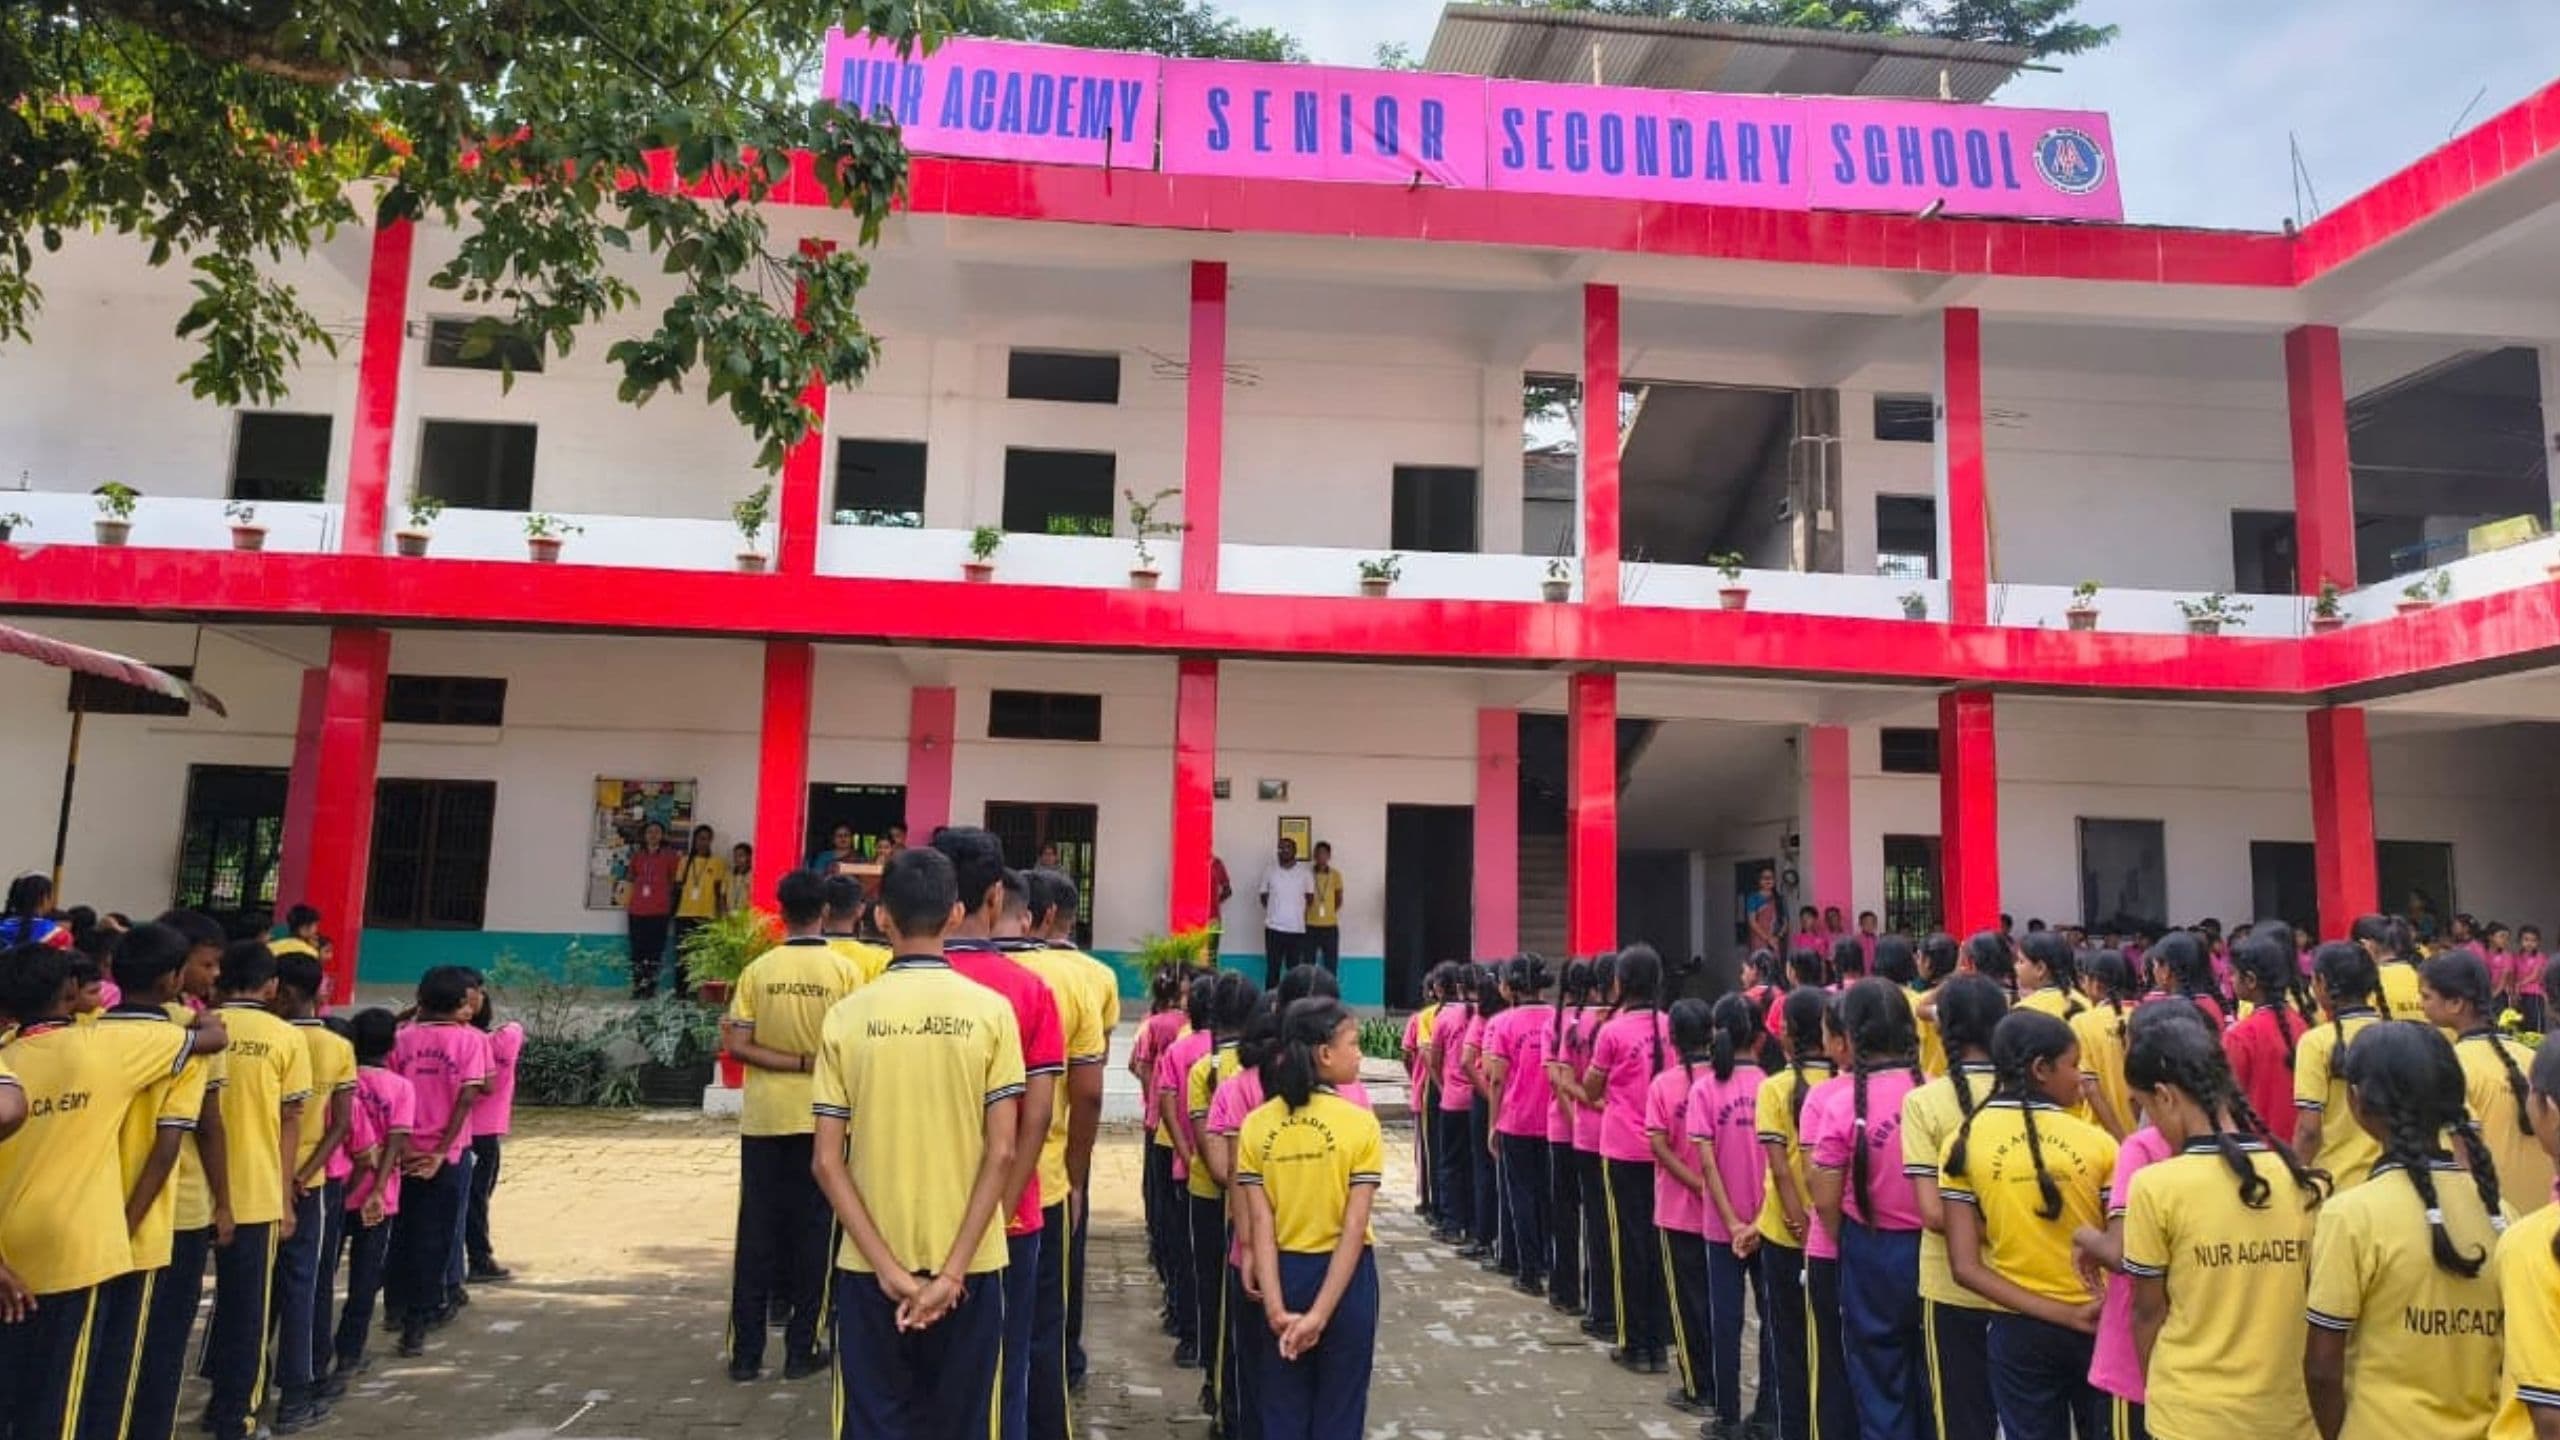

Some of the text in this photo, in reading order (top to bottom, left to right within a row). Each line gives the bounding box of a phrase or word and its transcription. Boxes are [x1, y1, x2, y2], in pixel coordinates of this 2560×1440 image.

[841, 57, 923, 126] NUR
[939, 65, 1143, 143] ACADEMY
[1207, 87, 1446, 162] SENIOR
[1502, 107, 1793, 186] SECONDARY
[1832, 123, 2022, 190] SCHOOL
[2194, 1243, 2233, 1268] NUR
[2404, 1306, 2447, 1336] NUR
